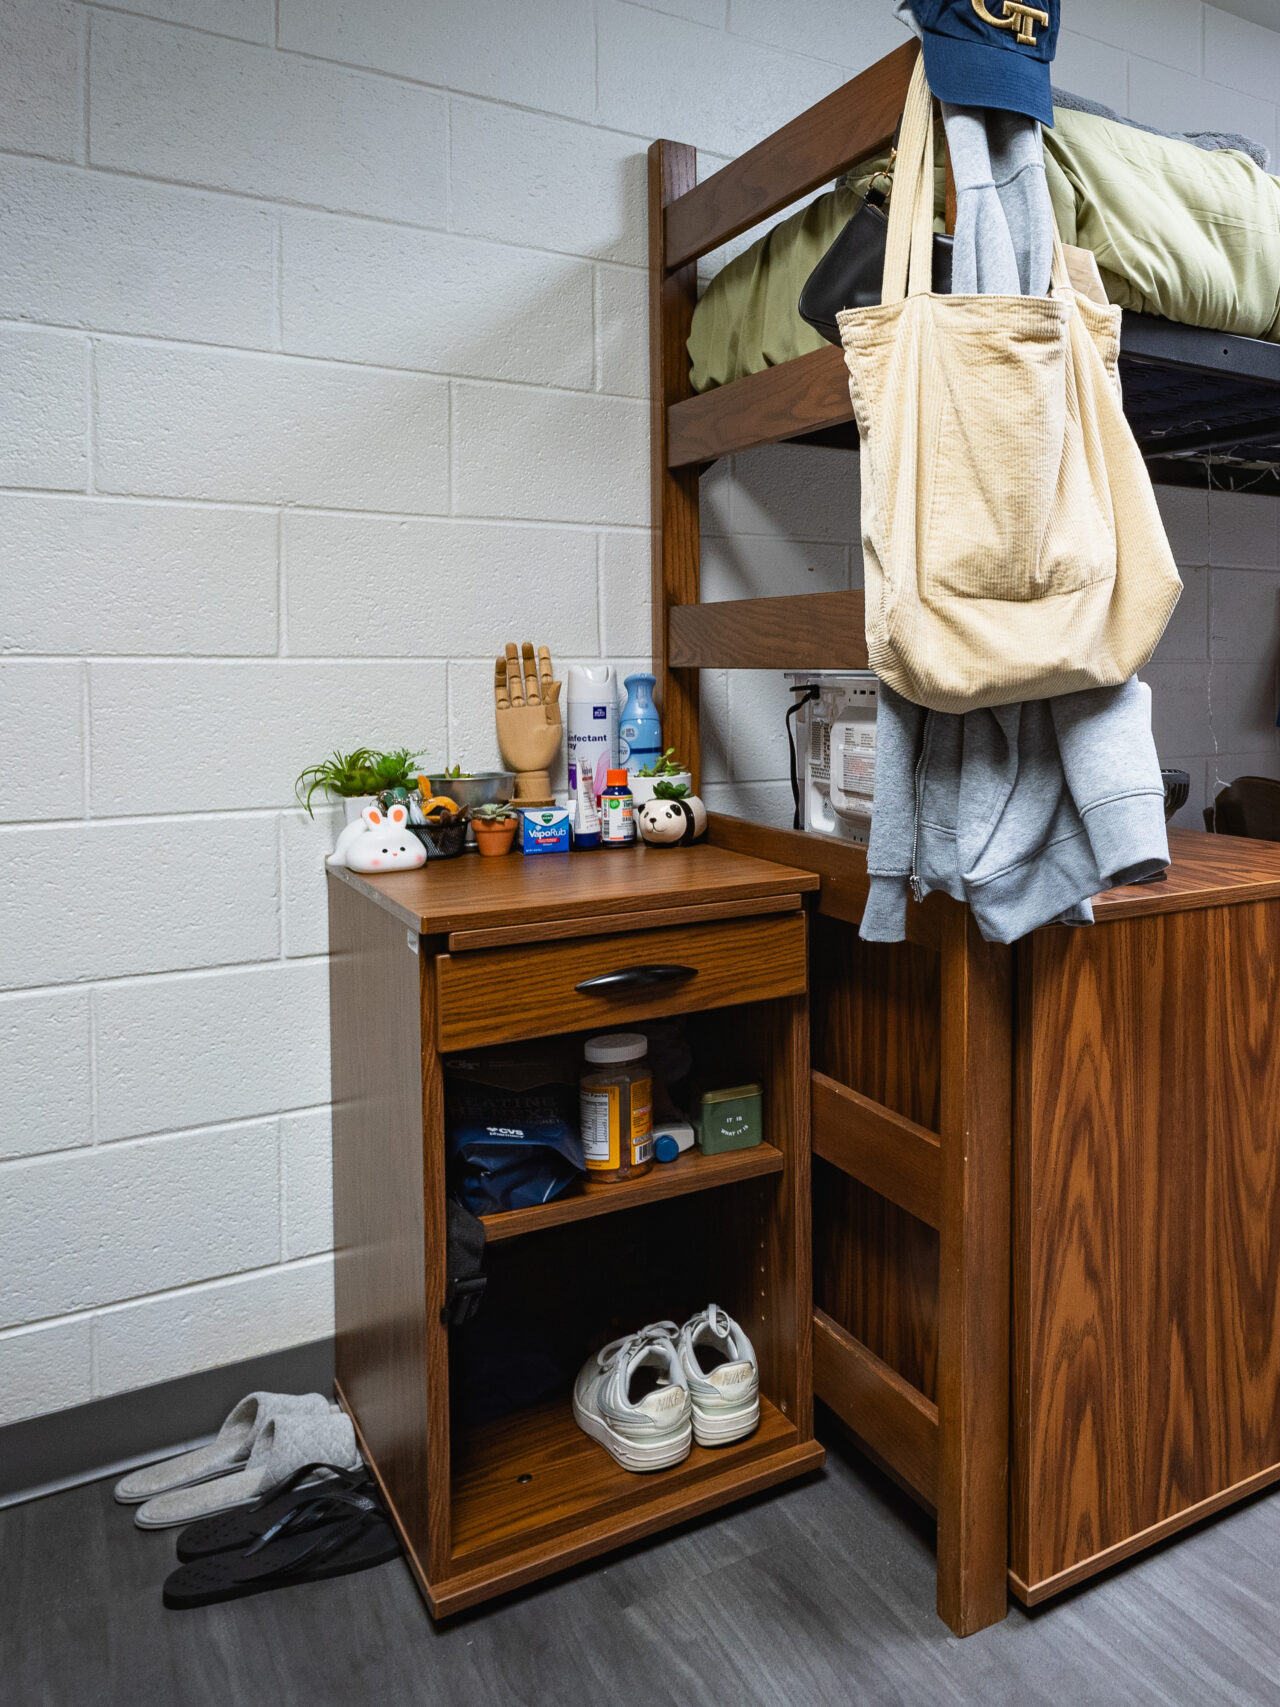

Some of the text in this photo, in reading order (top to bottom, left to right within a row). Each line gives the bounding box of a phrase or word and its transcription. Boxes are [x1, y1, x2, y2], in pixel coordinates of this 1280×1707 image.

[528, 828, 566, 839] VapoRub
[499, 1128, 524, 1136] CVS
[724, 1368, 748, 1385] NIKE
[656, 1391, 680, 1411] NIKE
